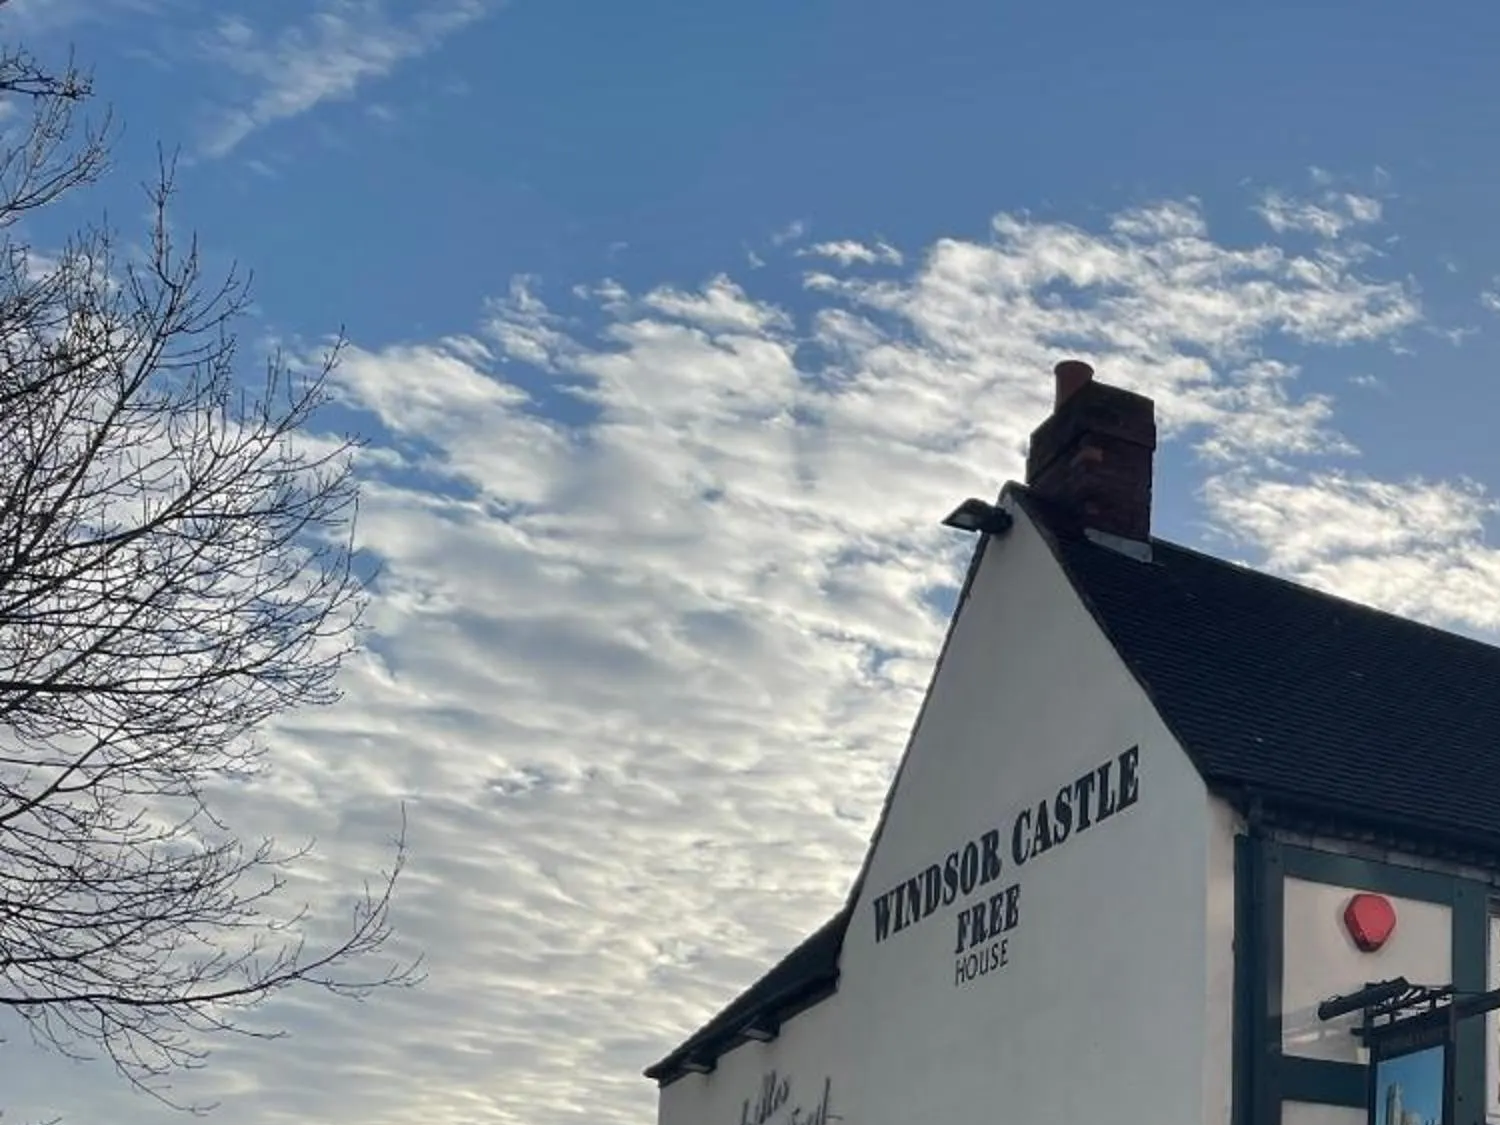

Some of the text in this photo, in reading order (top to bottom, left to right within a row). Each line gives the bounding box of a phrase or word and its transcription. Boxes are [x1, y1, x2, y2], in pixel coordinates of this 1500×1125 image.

[873, 745, 1139, 943] WINDSOR CASTLE
[954, 883, 1020, 953] FREE
[954, 939, 1008, 986] HOUSE
